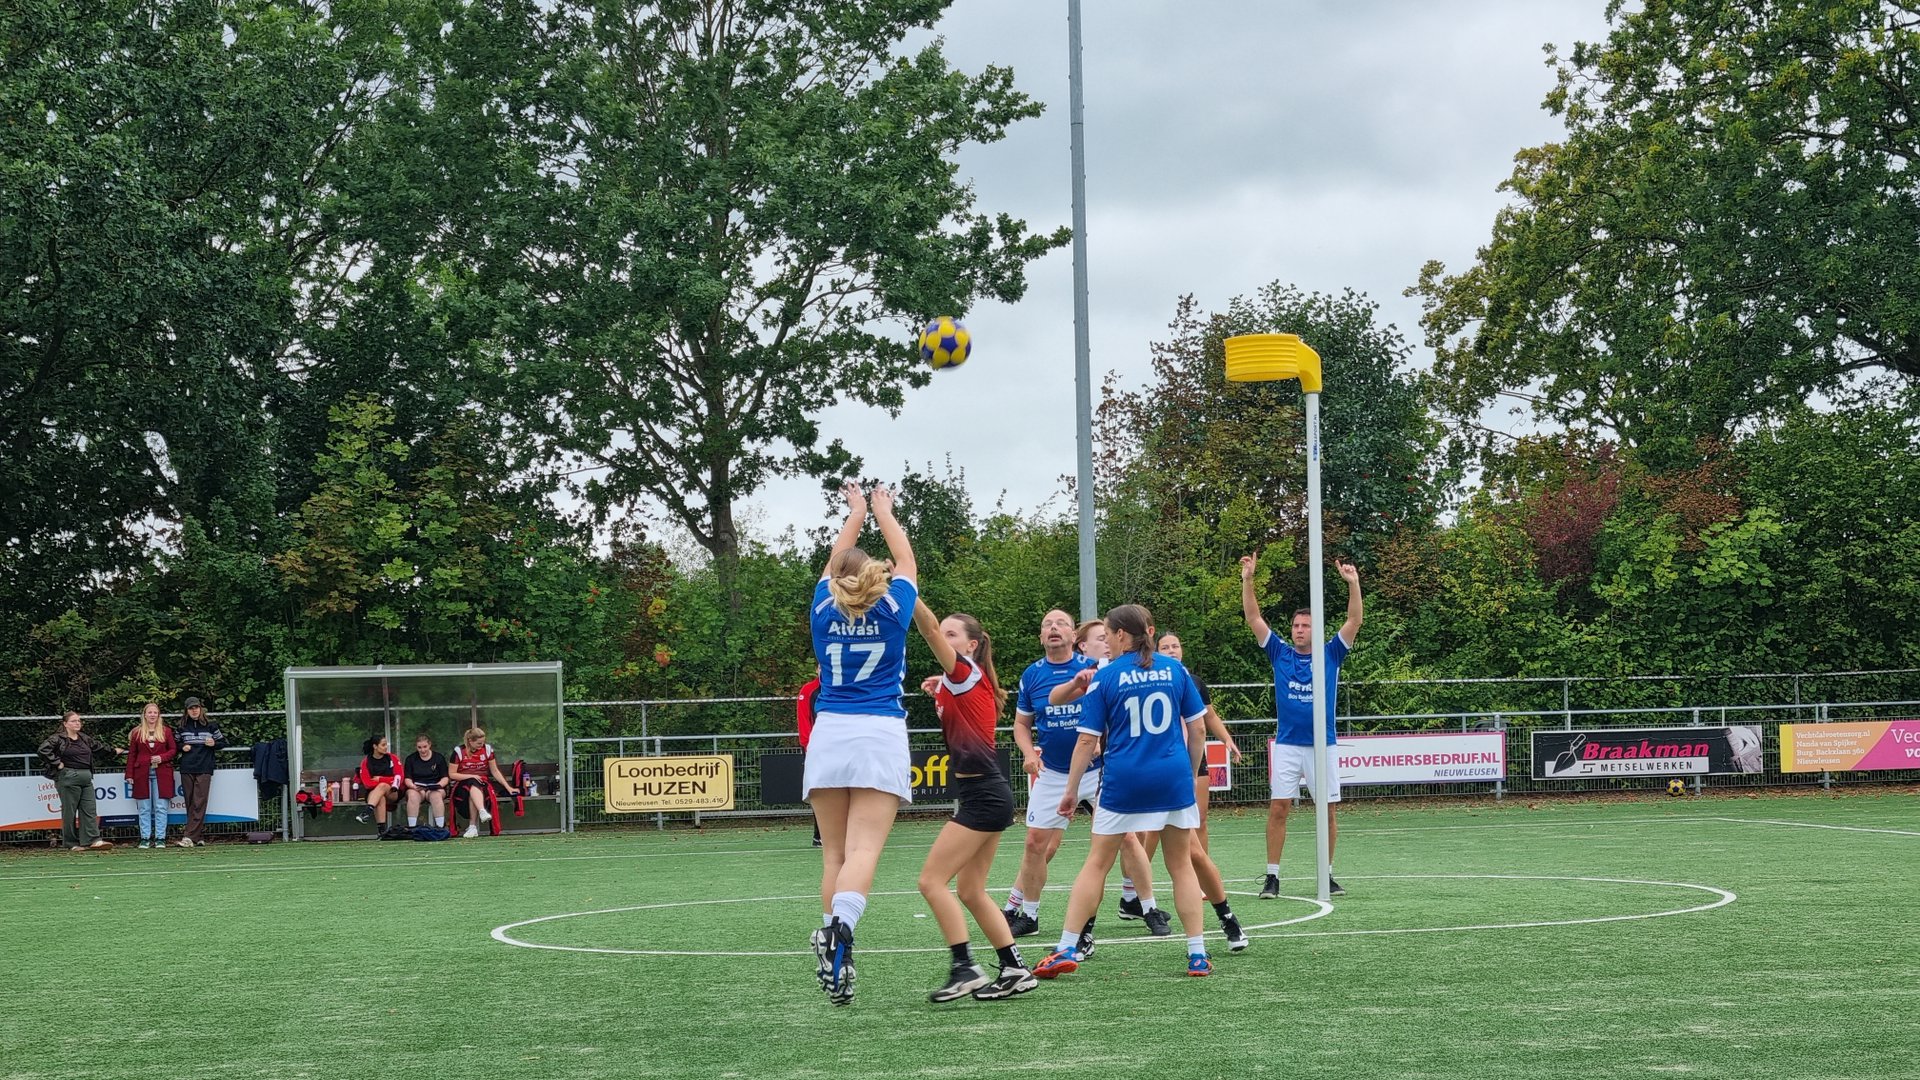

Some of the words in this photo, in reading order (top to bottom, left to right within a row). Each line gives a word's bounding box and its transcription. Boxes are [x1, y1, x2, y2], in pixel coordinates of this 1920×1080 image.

[828, 621, 879, 636] Alvasi
[825, 642, 886, 686] 17
[1119, 666, 1173, 687] Alvasi
[1288, 681, 1312, 692] PETR
[1045, 704, 1082, 716] PETRA
[1124, 691, 1172, 738] 10
[1582, 741, 1709, 760] Braakman
[1338, 752, 1500, 768] HOVENIERSBEDRIJF.NL
[1600, 761, 1693, 772] METSELWERKEN
[618, 762, 720, 779] Loonbedrijf
[1434, 768, 1497, 777] NIEUWLEUSEN
[95, 786, 117, 800] os
[633, 781, 706, 796] HUZEN
[1029, 811, 1035, 822] 6
